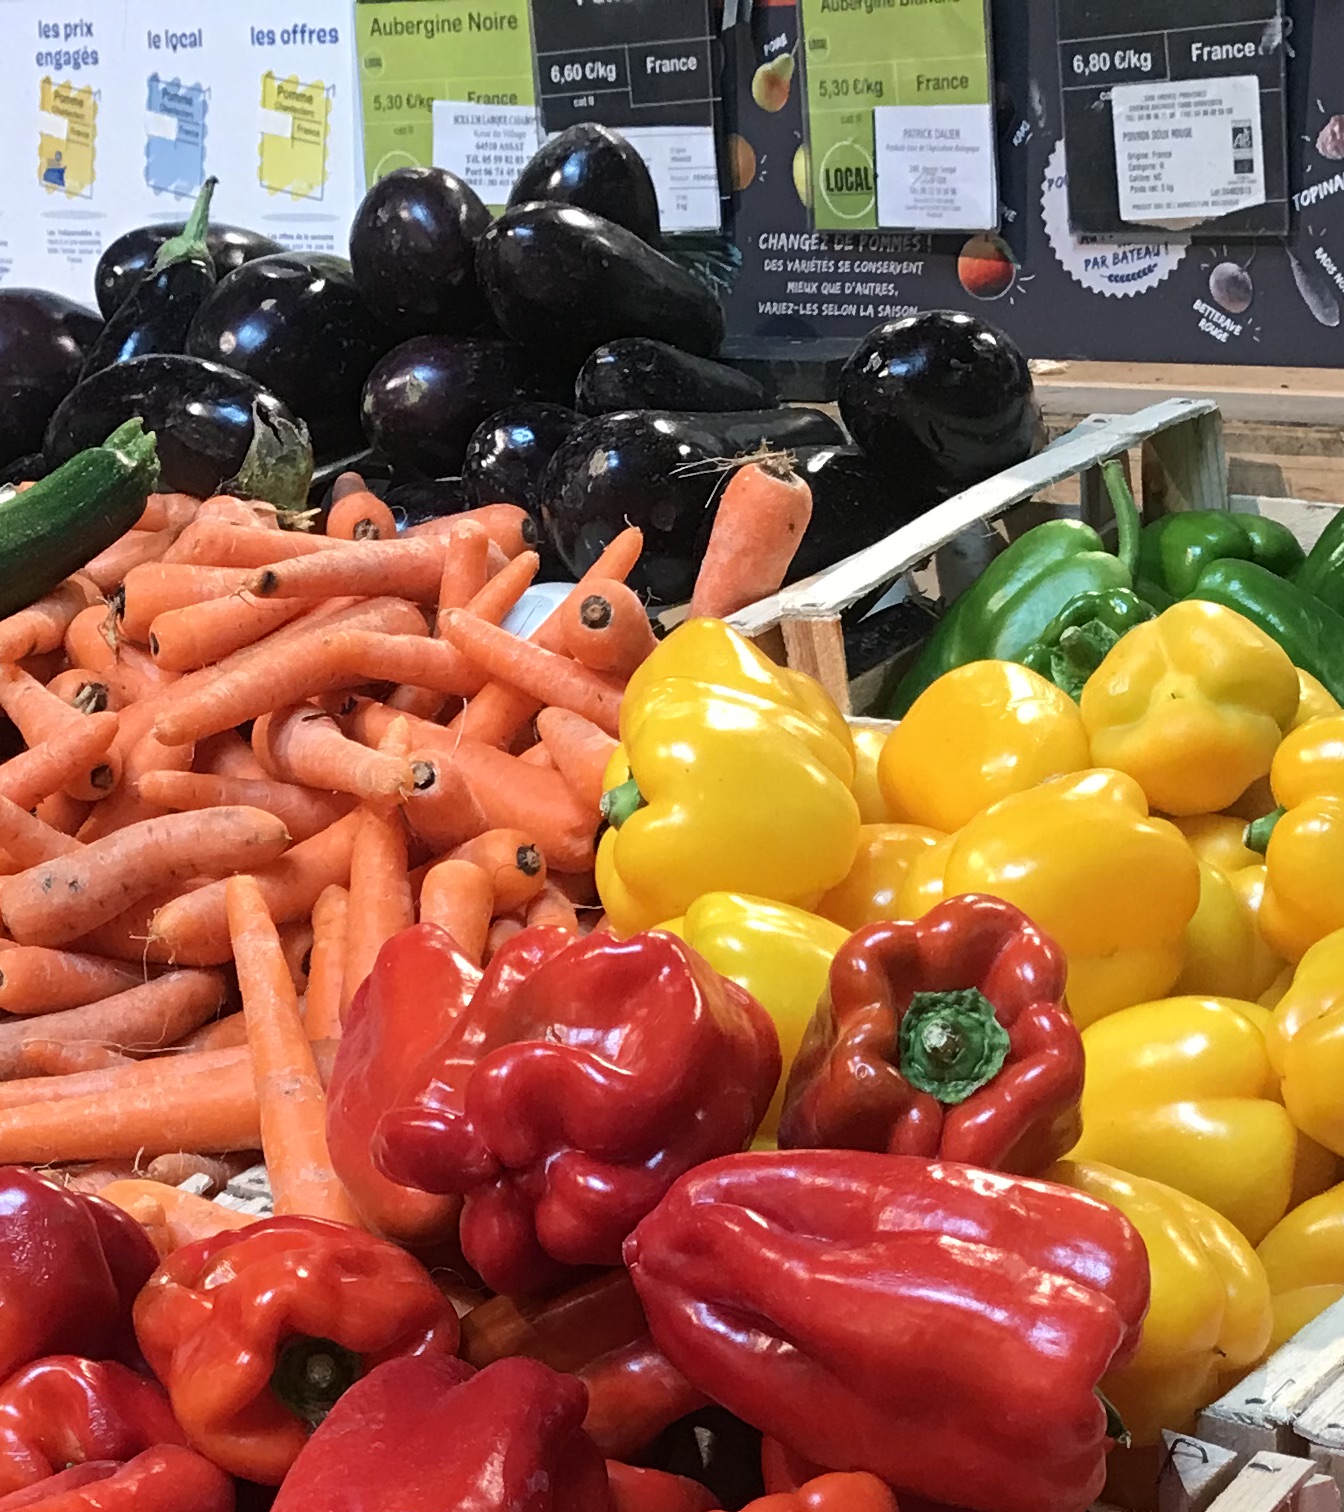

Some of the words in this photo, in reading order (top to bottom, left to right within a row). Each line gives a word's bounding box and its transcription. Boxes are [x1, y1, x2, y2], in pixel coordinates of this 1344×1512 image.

[38, 20, 60, 39] les
[64, 18, 94, 41] prix
[250, 26, 275, 46] les
[280, 23, 339, 45] offres
[370, 13, 462, 39] Aubergine
[468, 12, 518, 32] Noire
[147, 30, 161, 49] le
[165, 28, 203, 53] local
[1191, 42, 1256, 62] France
[36, 46, 99, 71] engagés
[646, 56, 697, 74] France
[1073, 54, 1110, 76] 6,80
[1114, 50, 1152, 72] €/kg
[551, 64, 583, 84] 6,60
[585, 61, 616, 82] €/kg
[916, 73, 969, 92] France
[819, 80, 849, 99] 5,30
[373, 94, 403, 111] 5,30
[826, 166, 872, 192] LOCAL
[758, 233, 828, 252] CHANGEZ
[834, 234, 854, 251] DE
[858, 234, 921, 252] POMMES
[764, 259, 784, 272] DES
[786, 257, 835, 273] VARIÉTÉS
[837, 260, 851, 273] SE
[854, 261, 924, 275] CONSERVENT
[1084, 256, 1109, 272] PAR
[1112, 243, 1160, 266] BATEAU
[1314, 246, 1336, 274] RADIS
[786, 281, 818, 295] MIEUX
[821, 282, 841, 295] QUE
[758, 302, 818, 315] VARIEZ-LES
[821, 303, 857, 316] SELON
[860, 304, 874, 318] LA
[1193, 299, 1243, 336] BETTERAVE
[1198, 318, 1230, 343] ROUGE
